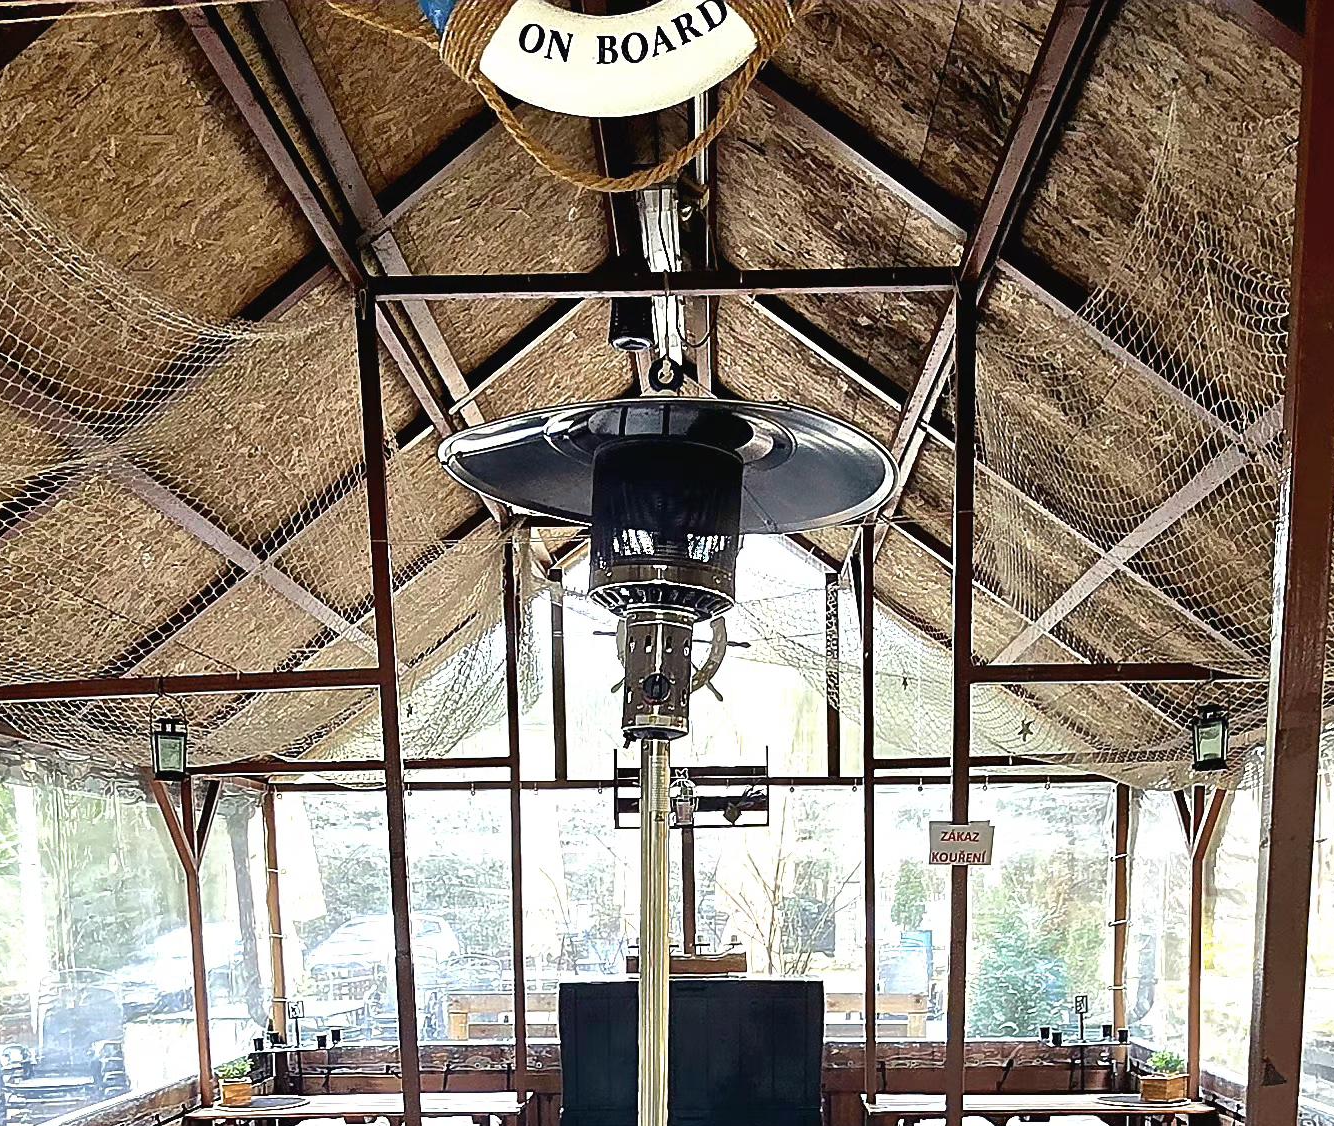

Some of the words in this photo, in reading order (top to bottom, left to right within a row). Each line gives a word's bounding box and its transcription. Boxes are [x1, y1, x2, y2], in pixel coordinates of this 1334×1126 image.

[518, 23, 573, 63] ON
[596, 0, 728, 65] BOARD
[940, 829, 980, 842] ZÁKAZ
[931, 850, 987, 863] KOUŘENÍ
